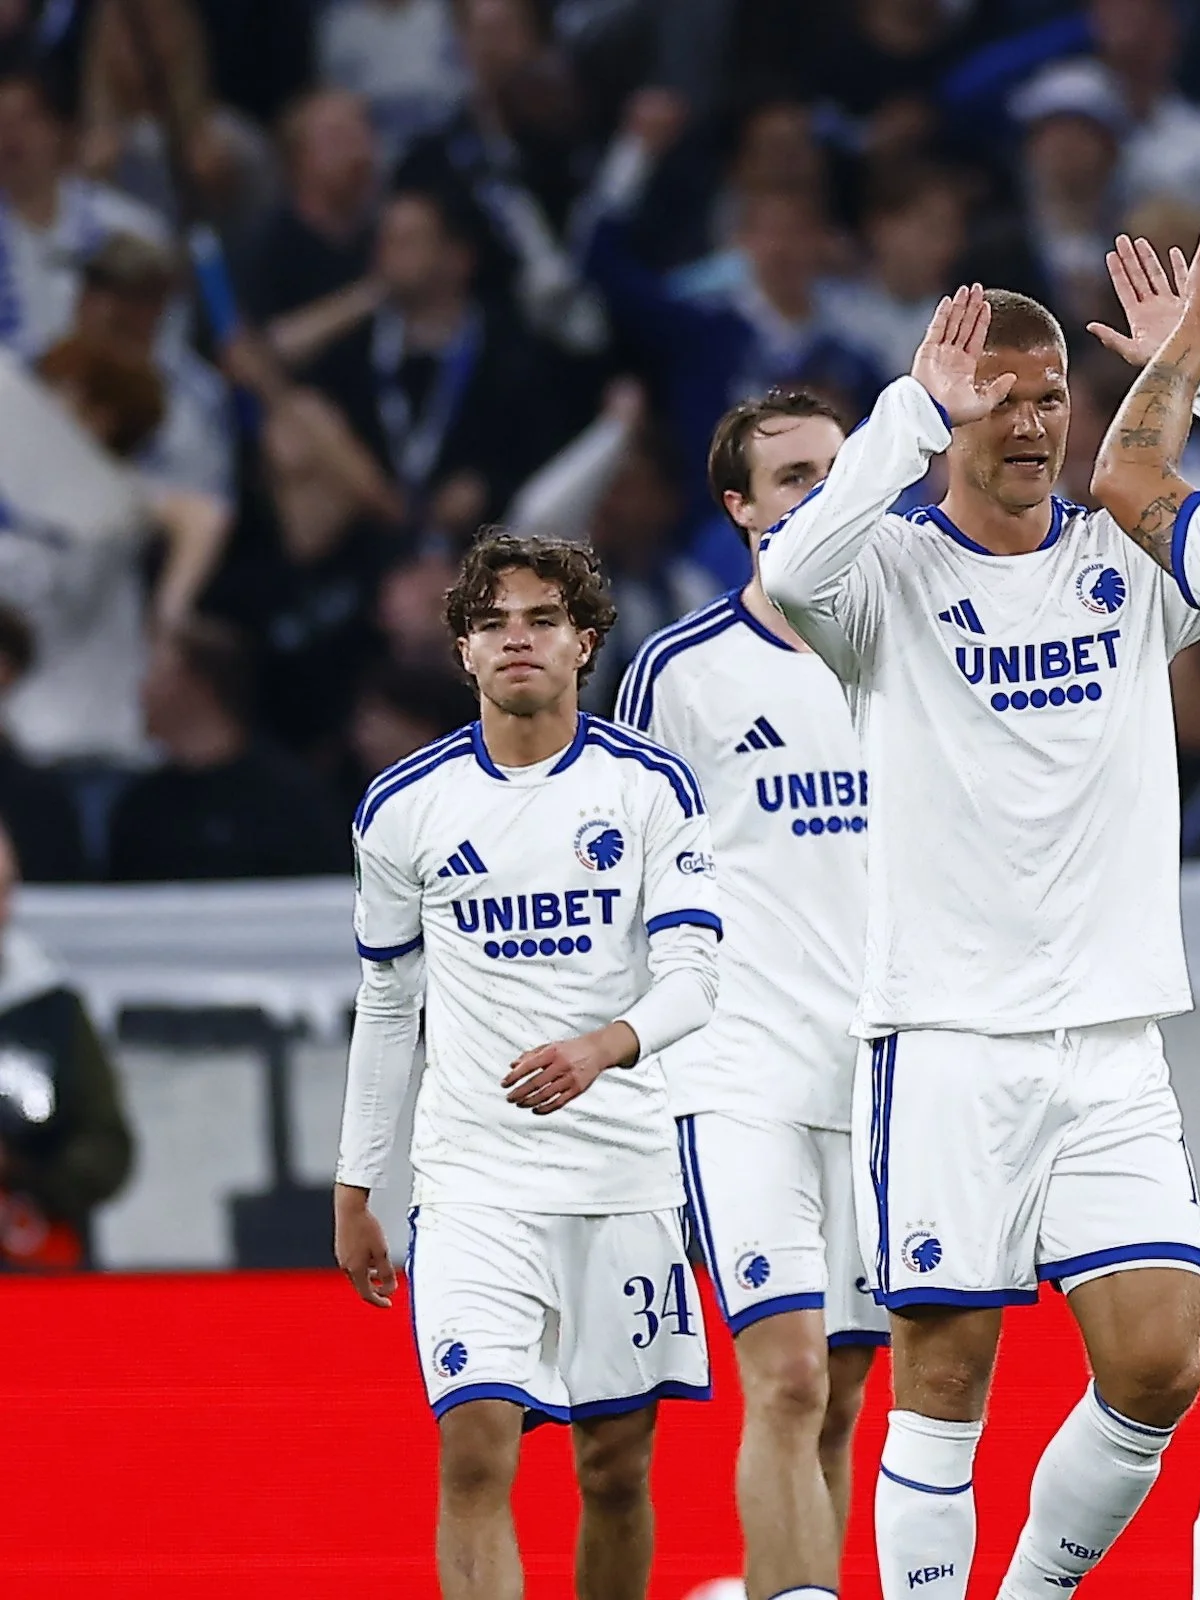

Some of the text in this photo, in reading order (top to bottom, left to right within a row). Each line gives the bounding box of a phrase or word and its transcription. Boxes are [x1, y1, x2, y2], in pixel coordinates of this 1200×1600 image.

[955, 629, 1121, 685] UNIBET
[452, 888, 621, 933] UNIBET
[622, 1262, 698, 1350] 34
[1060, 1537, 1104, 1560] KBH
[907, 1563, 955, 1589] KBH
